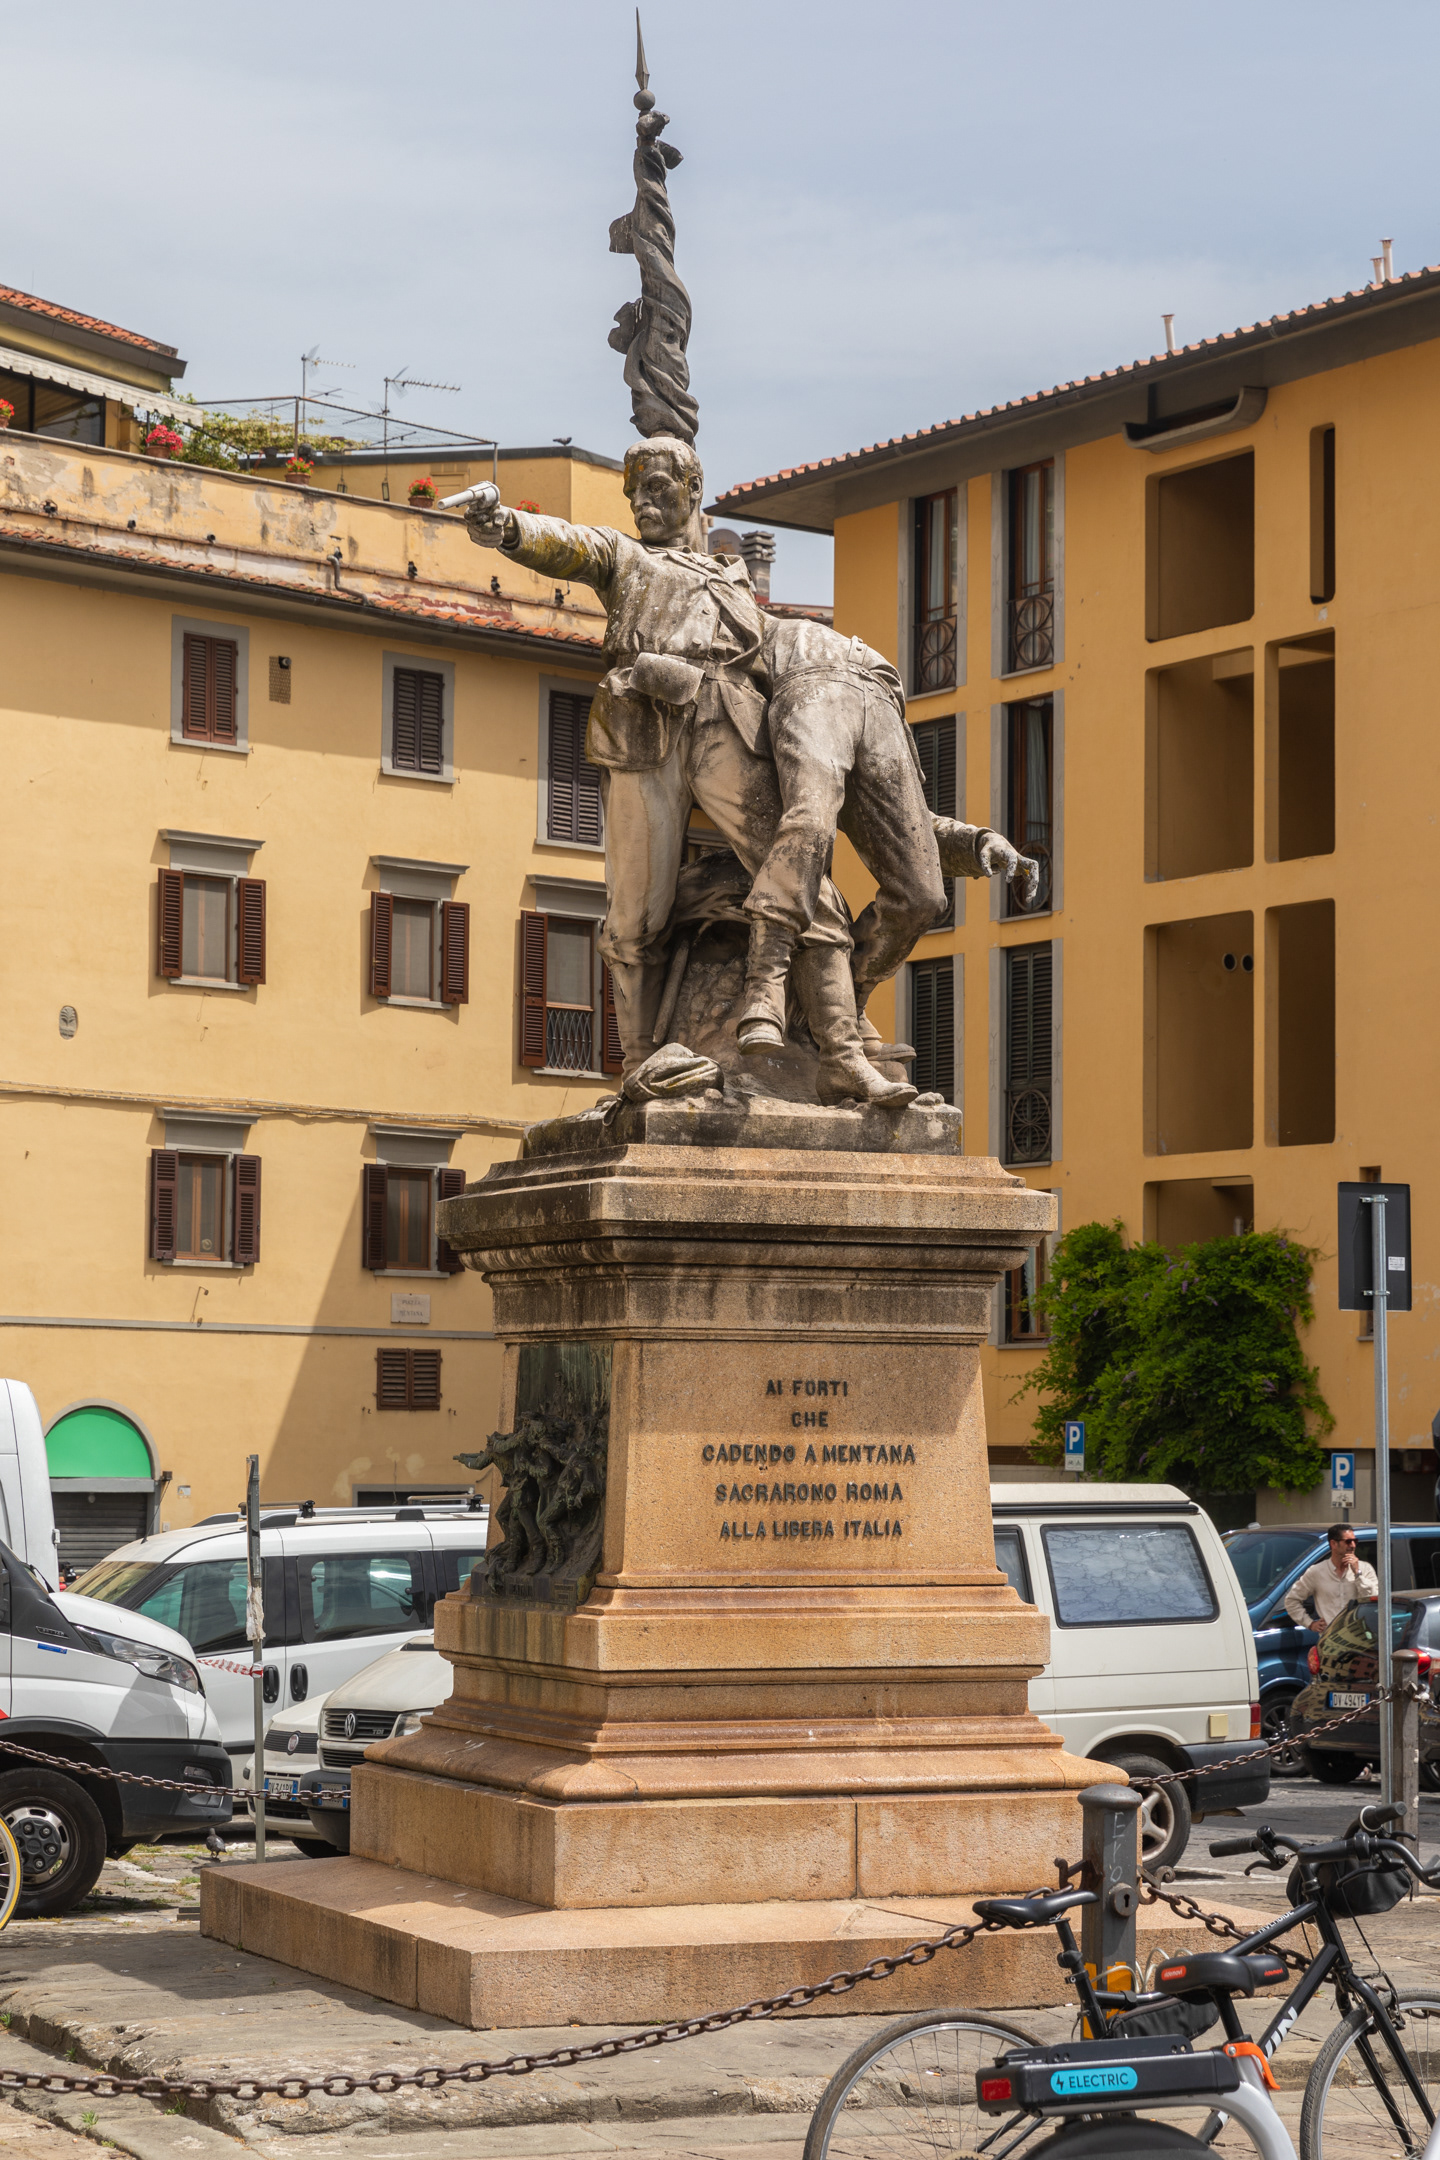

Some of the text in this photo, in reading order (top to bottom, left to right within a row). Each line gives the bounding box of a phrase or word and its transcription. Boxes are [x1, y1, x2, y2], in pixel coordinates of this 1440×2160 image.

[766, 1379, 848, 1397] AI FORTI
[791, 1411, 829, 1427] CHE
[1069, 1425, 1081, 1450] P
[703, 1444, 916, 1463] CADENDO A MENTANA
[1335, 1457, 1350, 1486] P
[716, 1483, 903, 1501] SACRARONO ROMA
[721, 1520, 902, 1537] ALLA LIBERA ITALIA
[1068, 2072, 1129, 2089] ELECTRIC
